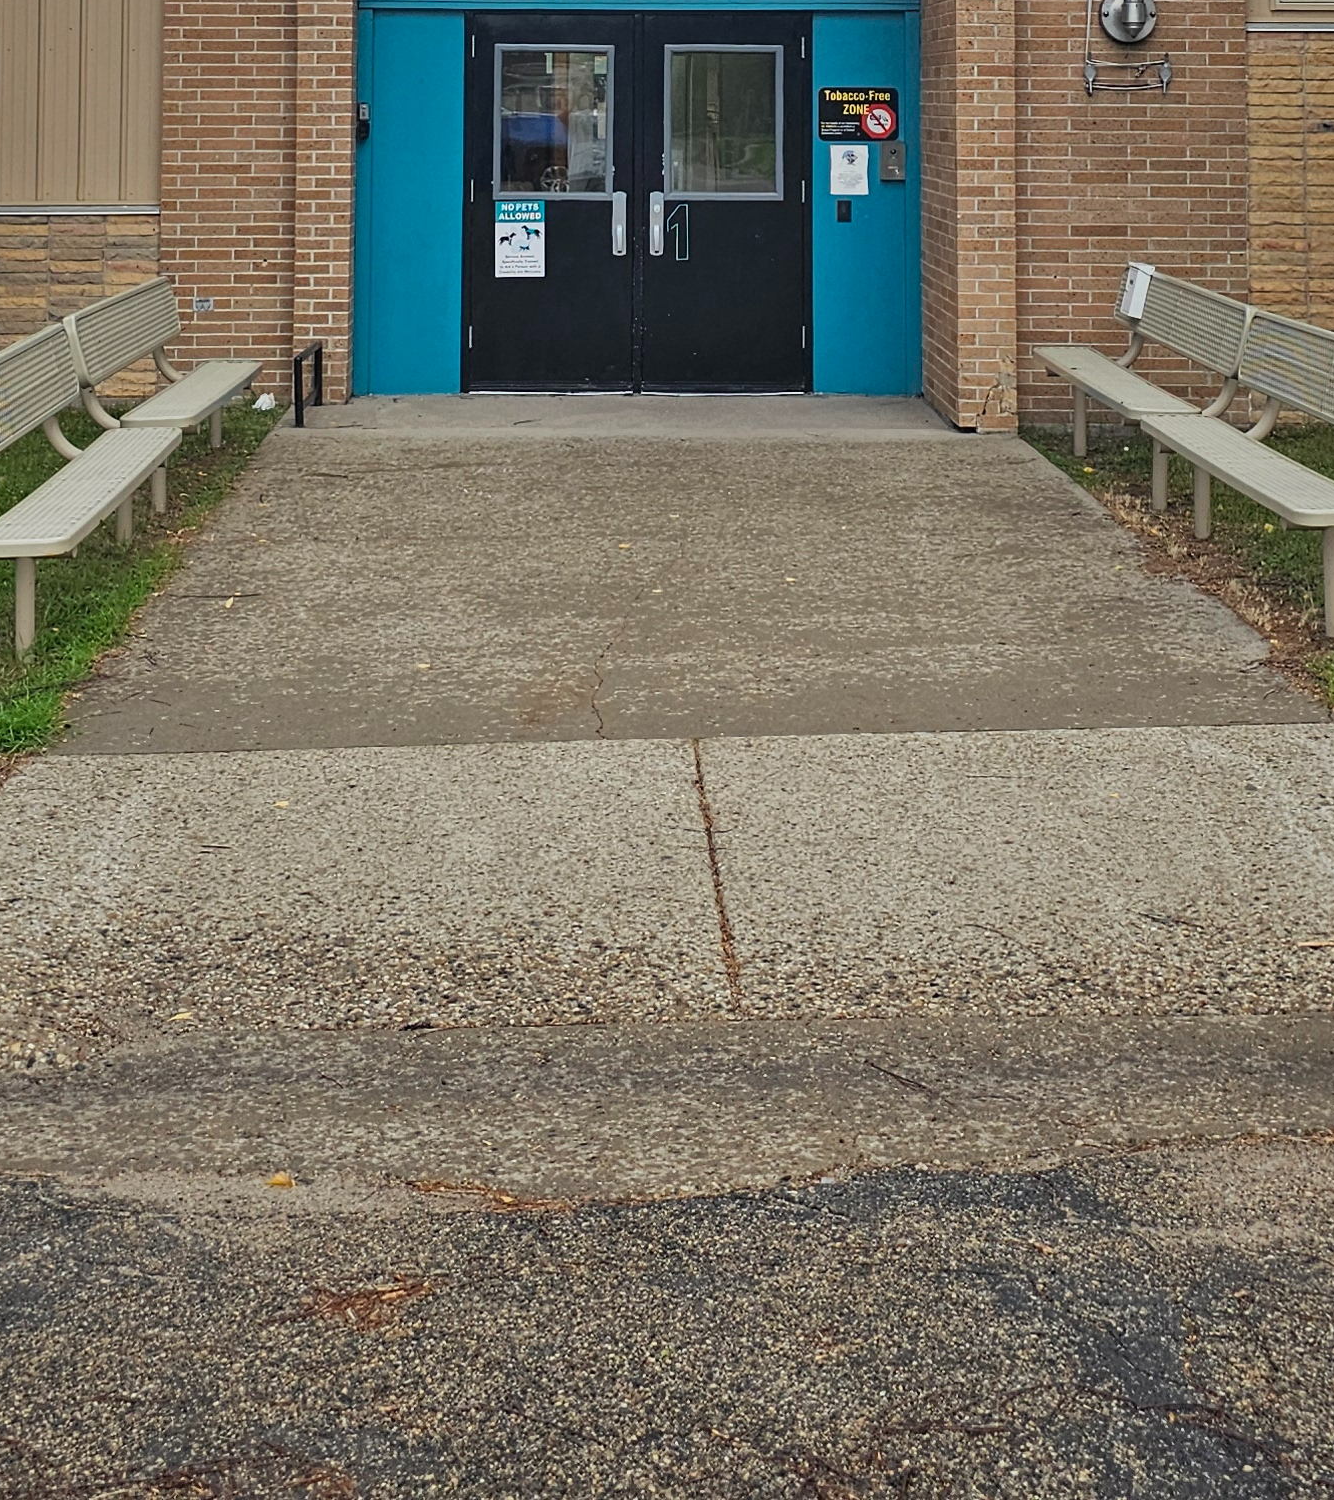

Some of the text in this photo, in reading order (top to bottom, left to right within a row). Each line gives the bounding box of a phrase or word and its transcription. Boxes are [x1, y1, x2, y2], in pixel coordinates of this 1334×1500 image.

[843, 103, 870, 115] ZONE
[501, 203, 539, 211] NO PETS
[498, 212, 542, 220] ALLOWED
[667, 203, 689, 261] 1
